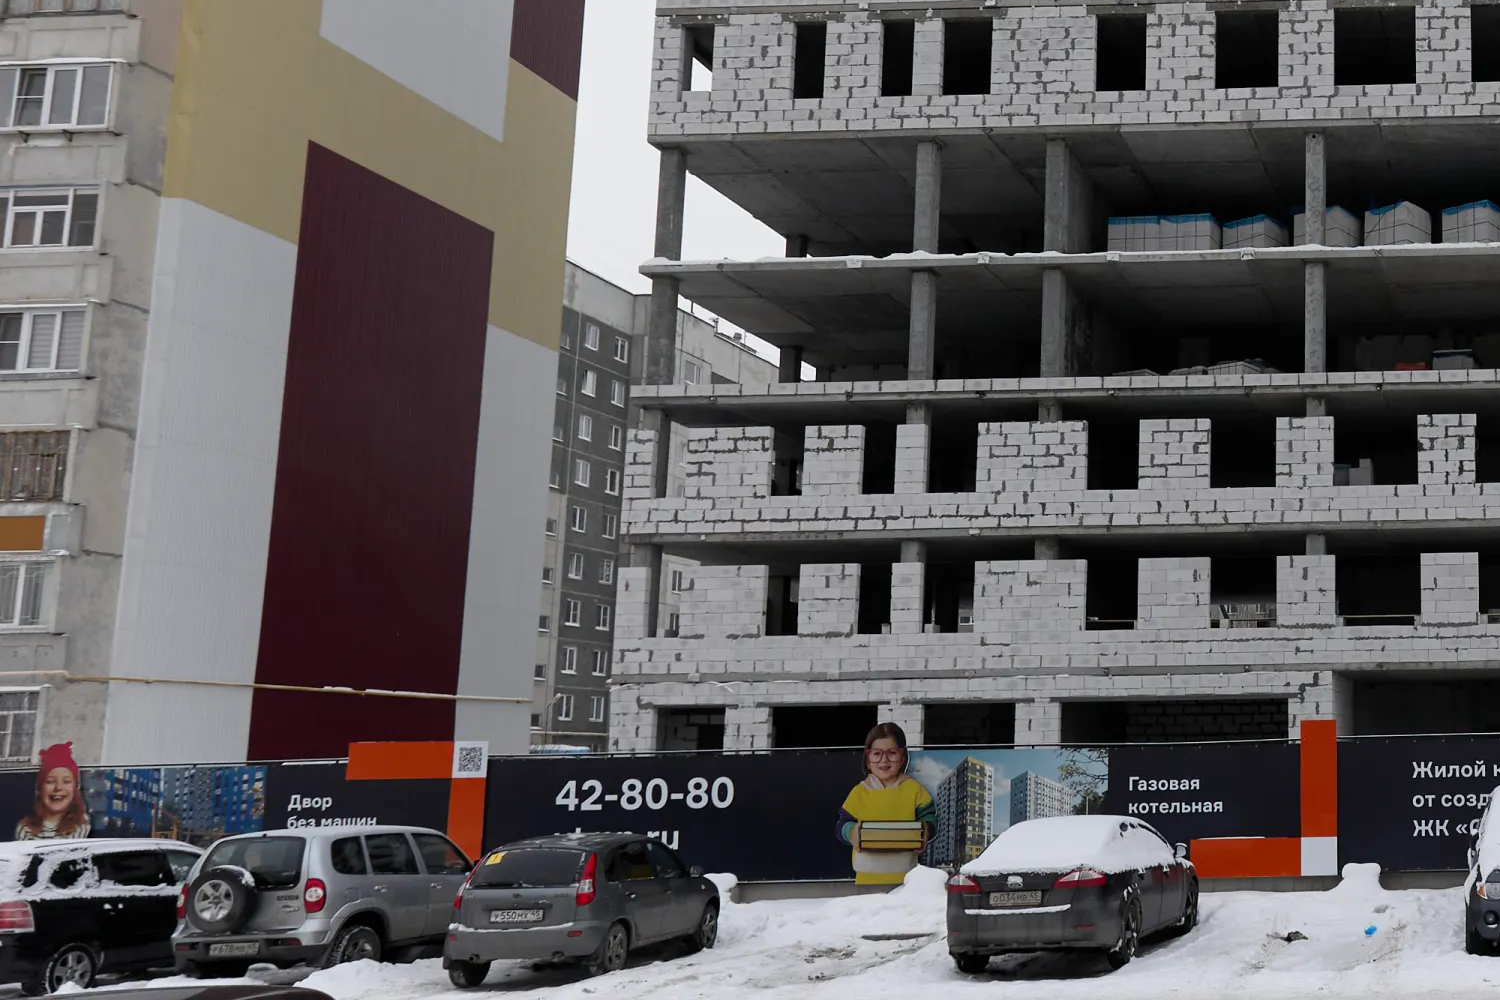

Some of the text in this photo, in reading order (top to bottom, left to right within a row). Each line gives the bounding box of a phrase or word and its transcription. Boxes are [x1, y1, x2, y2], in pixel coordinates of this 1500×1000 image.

[1412, 760, 1486, 778] Жилой
[1128, 776, 1200, 791] Газовая
[555, 776, 735, 811] 42-80-80
[1412, 793, 1491, 809] от созд
[287, 794, 333, 812] Двор
[1128, 801, 1223, 814] котельная
[287, 816, 377, 829] без машин
[1413, 819, 1450, 837] ЖК
